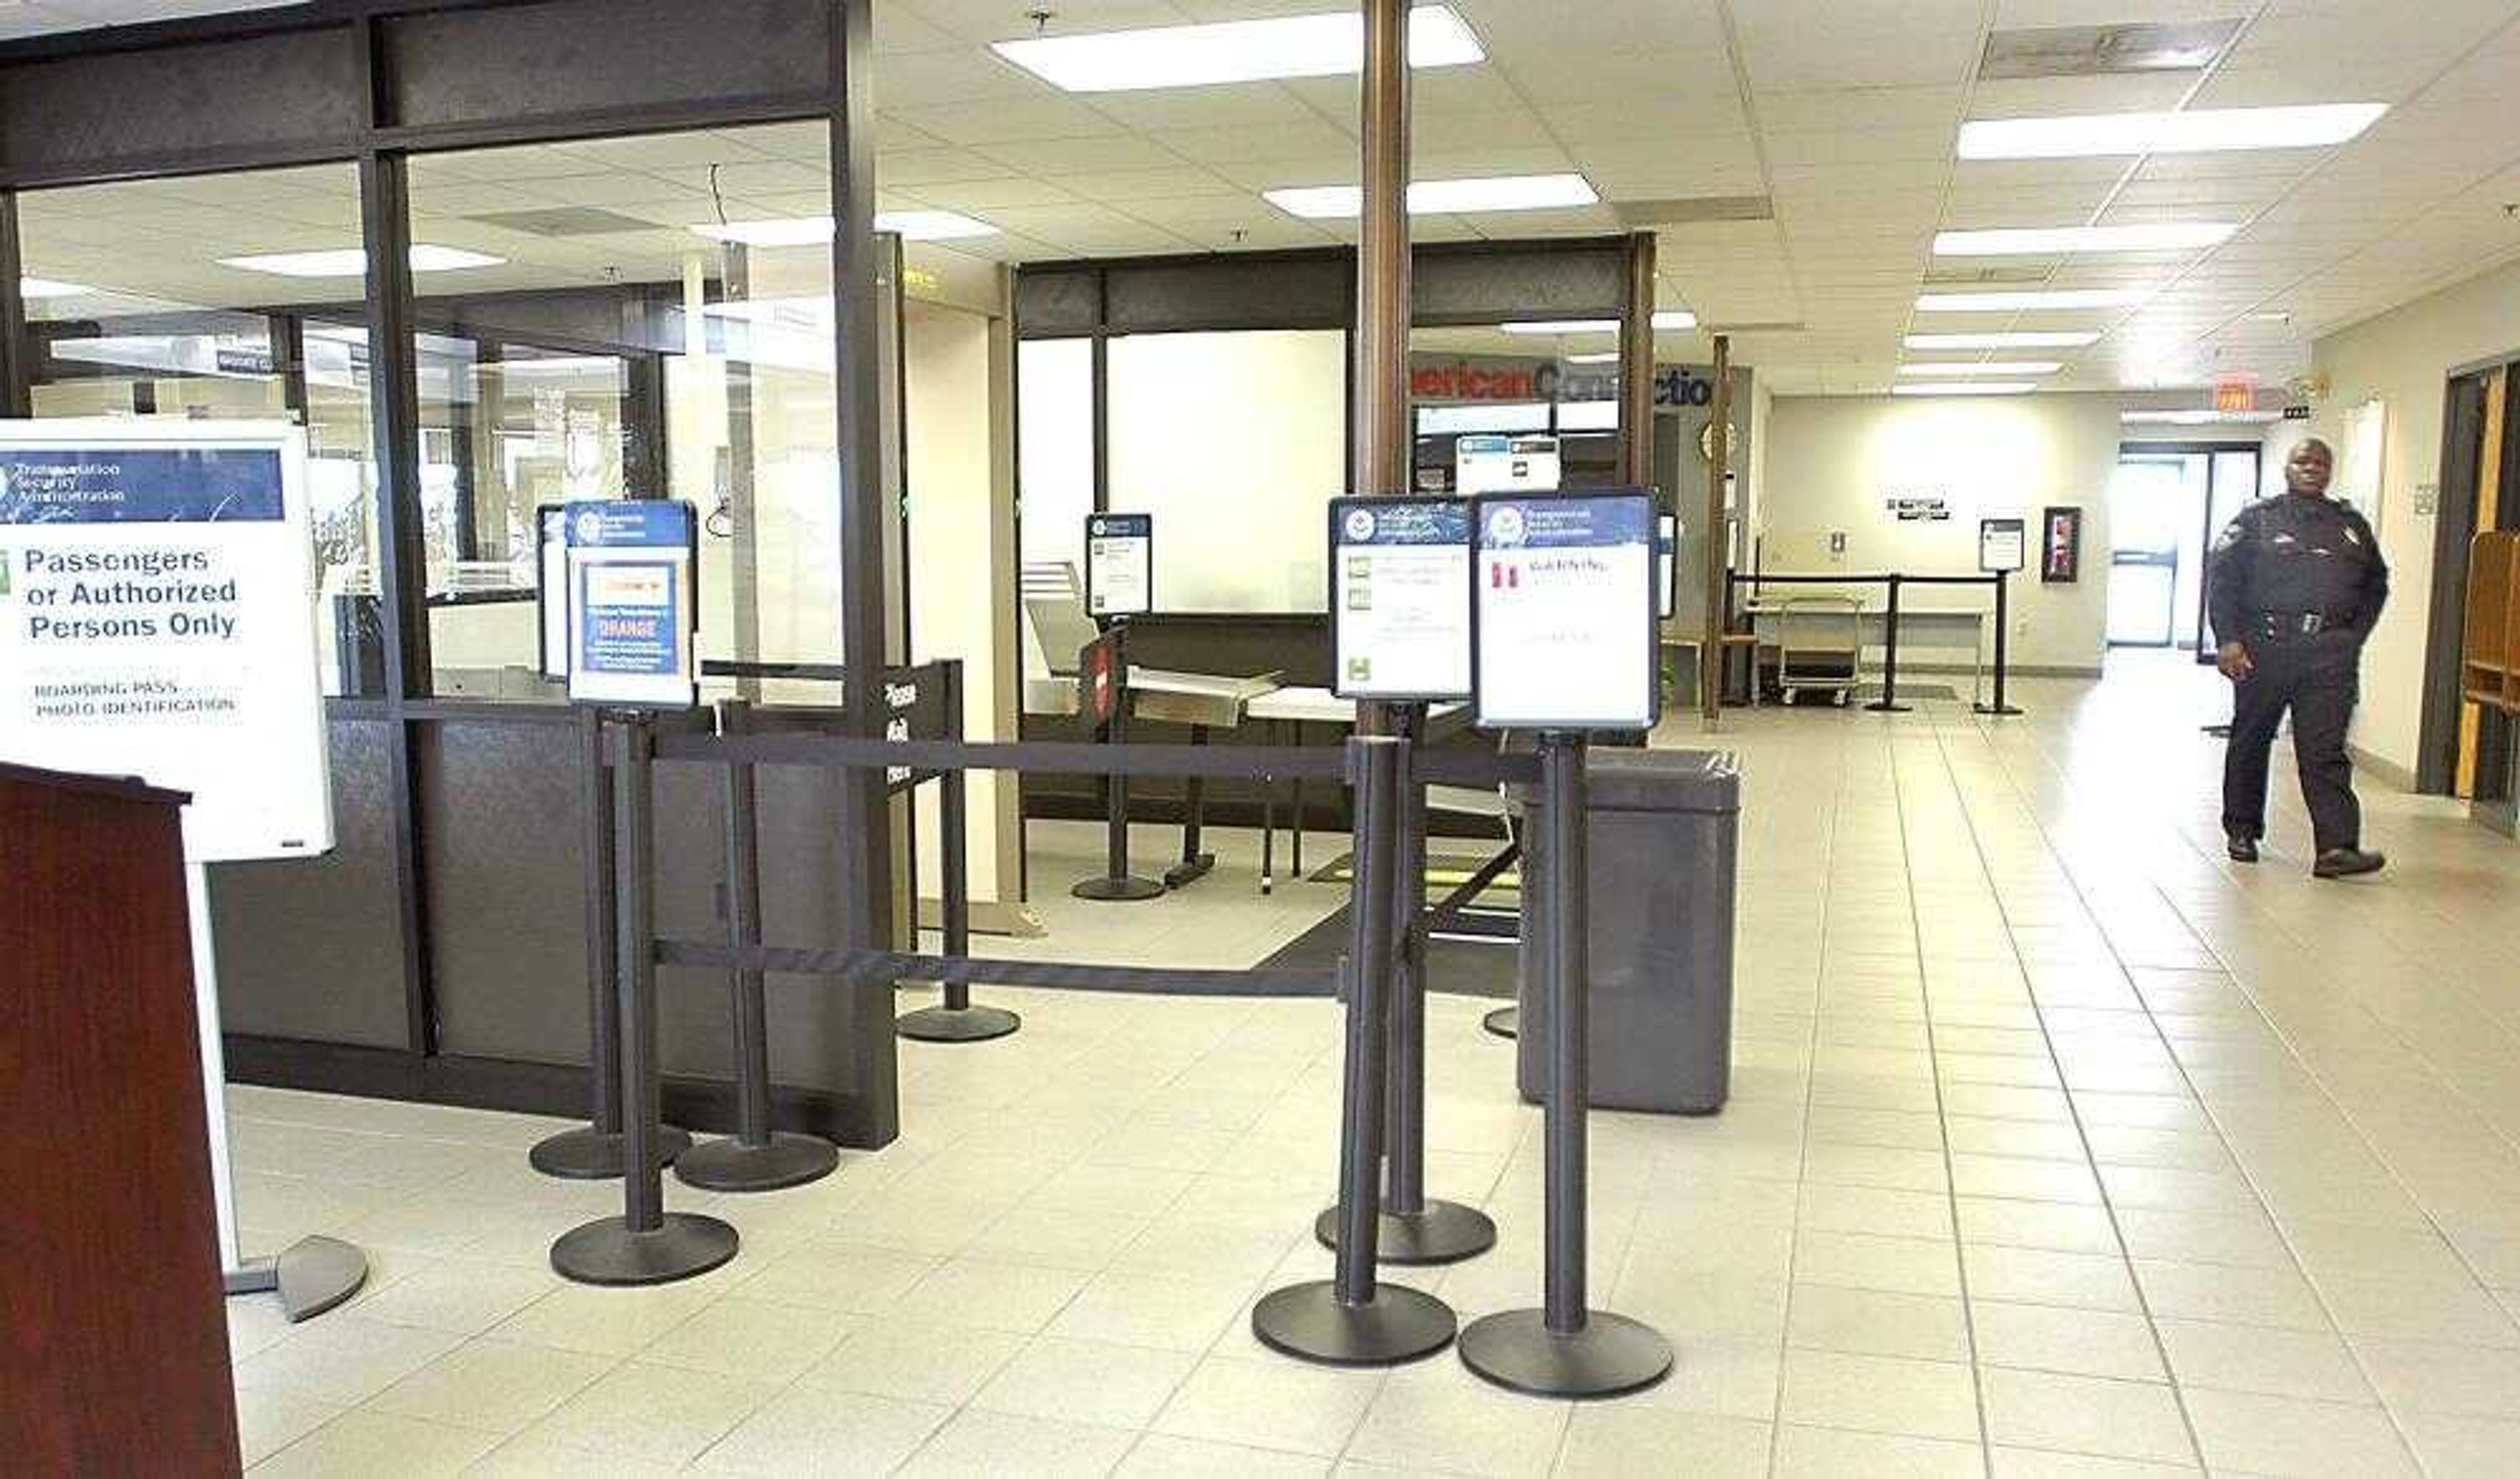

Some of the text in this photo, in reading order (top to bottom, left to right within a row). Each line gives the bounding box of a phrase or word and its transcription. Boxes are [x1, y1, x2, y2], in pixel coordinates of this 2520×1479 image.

[26, 550, 208, 575] Passengers
[28, 578, 236, 605] or Authorized
[31, 612, 235, 639] Persons Only
[133, 681, 177, 694] PASS
[37, 699, 236, 717] PHOTO IDENTIFICATION
